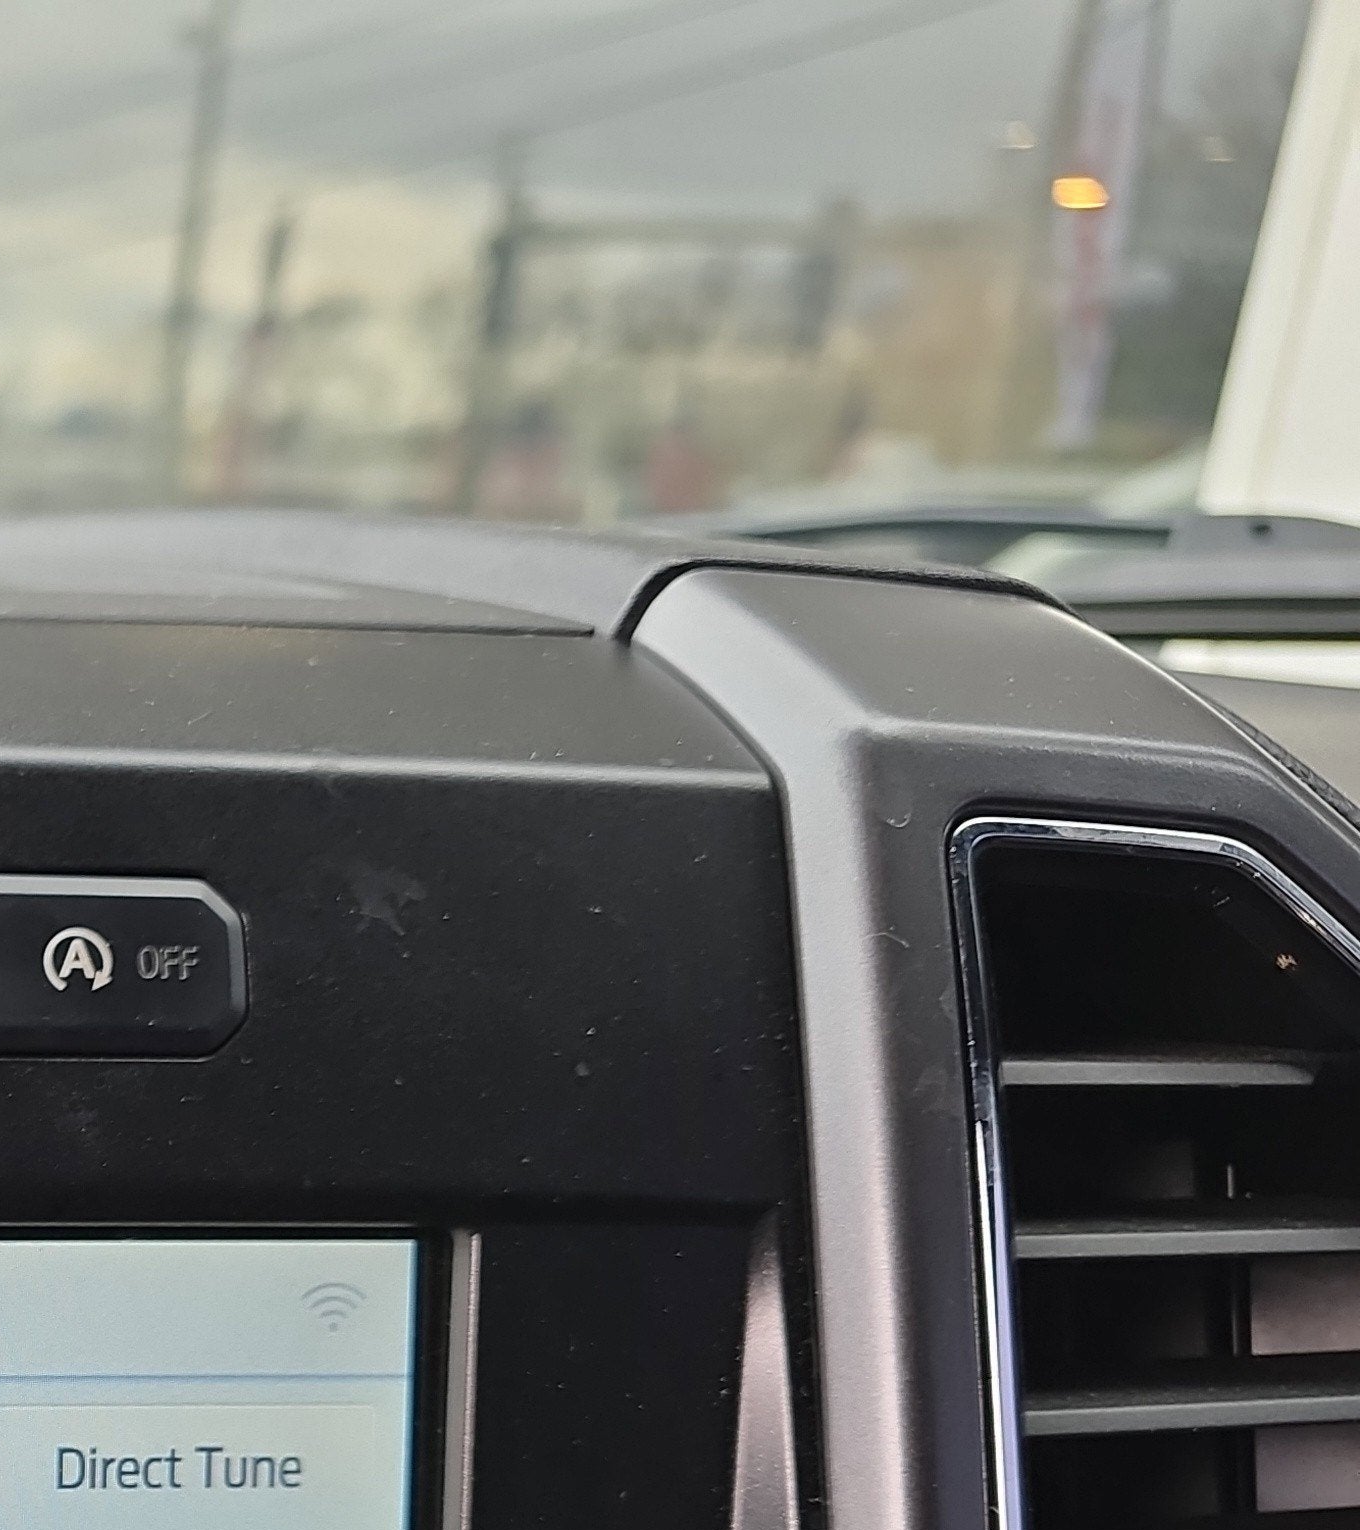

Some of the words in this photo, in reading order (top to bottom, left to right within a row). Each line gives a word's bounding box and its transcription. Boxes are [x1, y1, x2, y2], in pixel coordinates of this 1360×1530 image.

[138, 946, 198, 979] OFF
[57, 1447, 182, 1490] Direct
[195, 1446, 302, 1489] Tune
